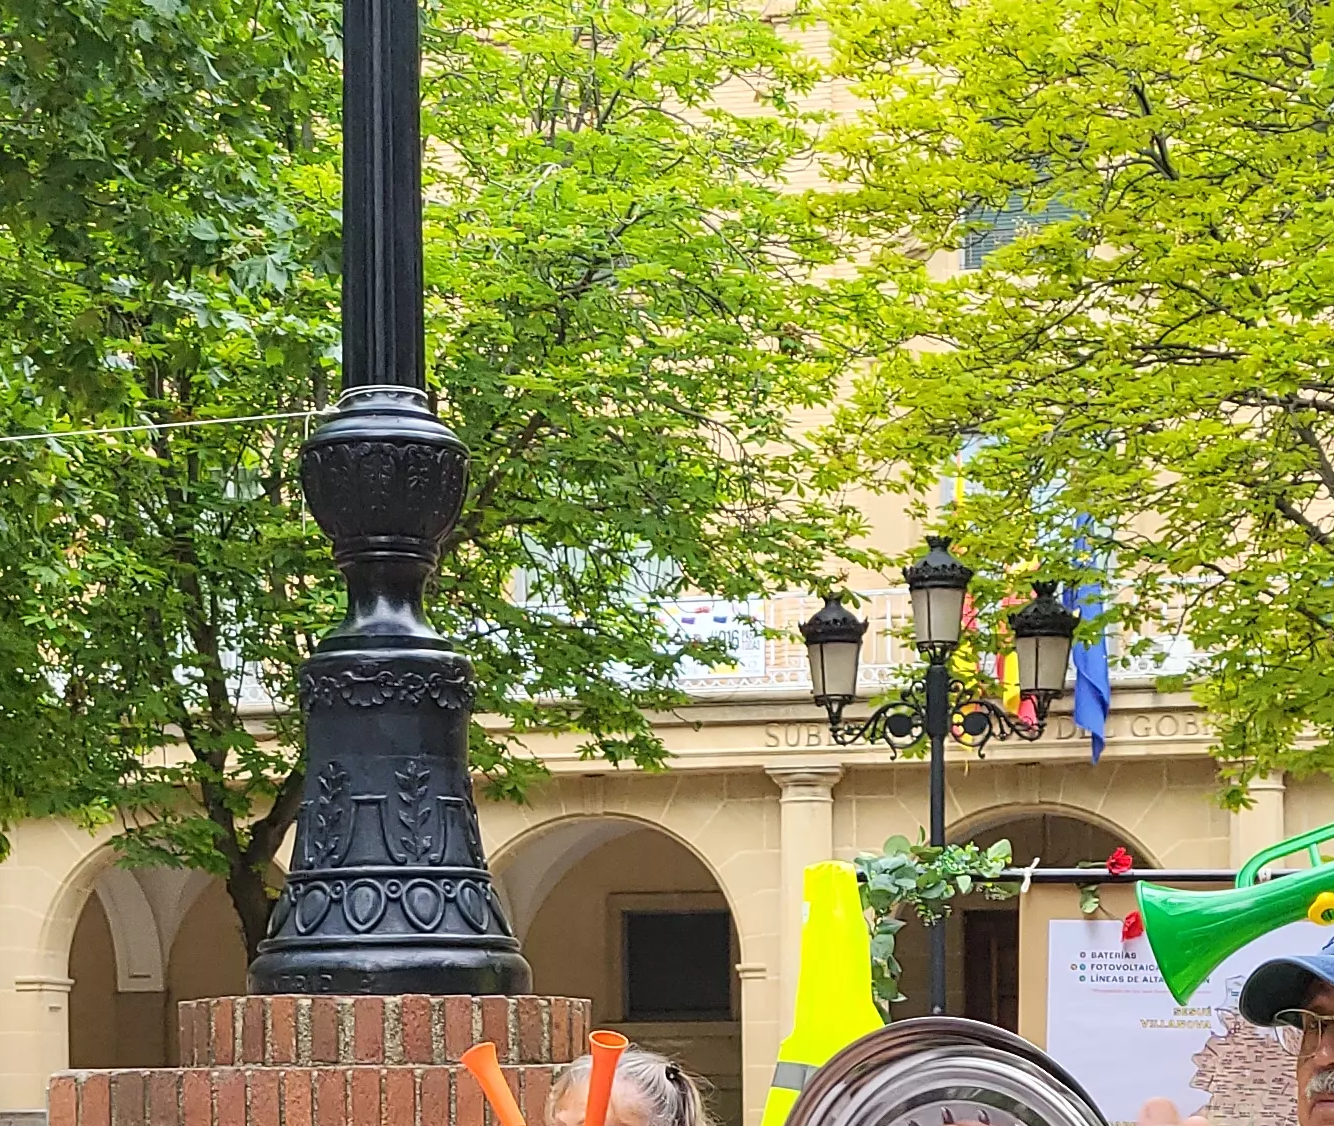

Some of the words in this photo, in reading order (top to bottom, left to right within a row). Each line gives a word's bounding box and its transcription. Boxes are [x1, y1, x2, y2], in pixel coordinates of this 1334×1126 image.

[1090, 950, 1137, 960] BATERÍAS
[1090, 974, 1125, 983] LÍNEAS
[1140, 1018, 1212, 1029] VILLANOVA
